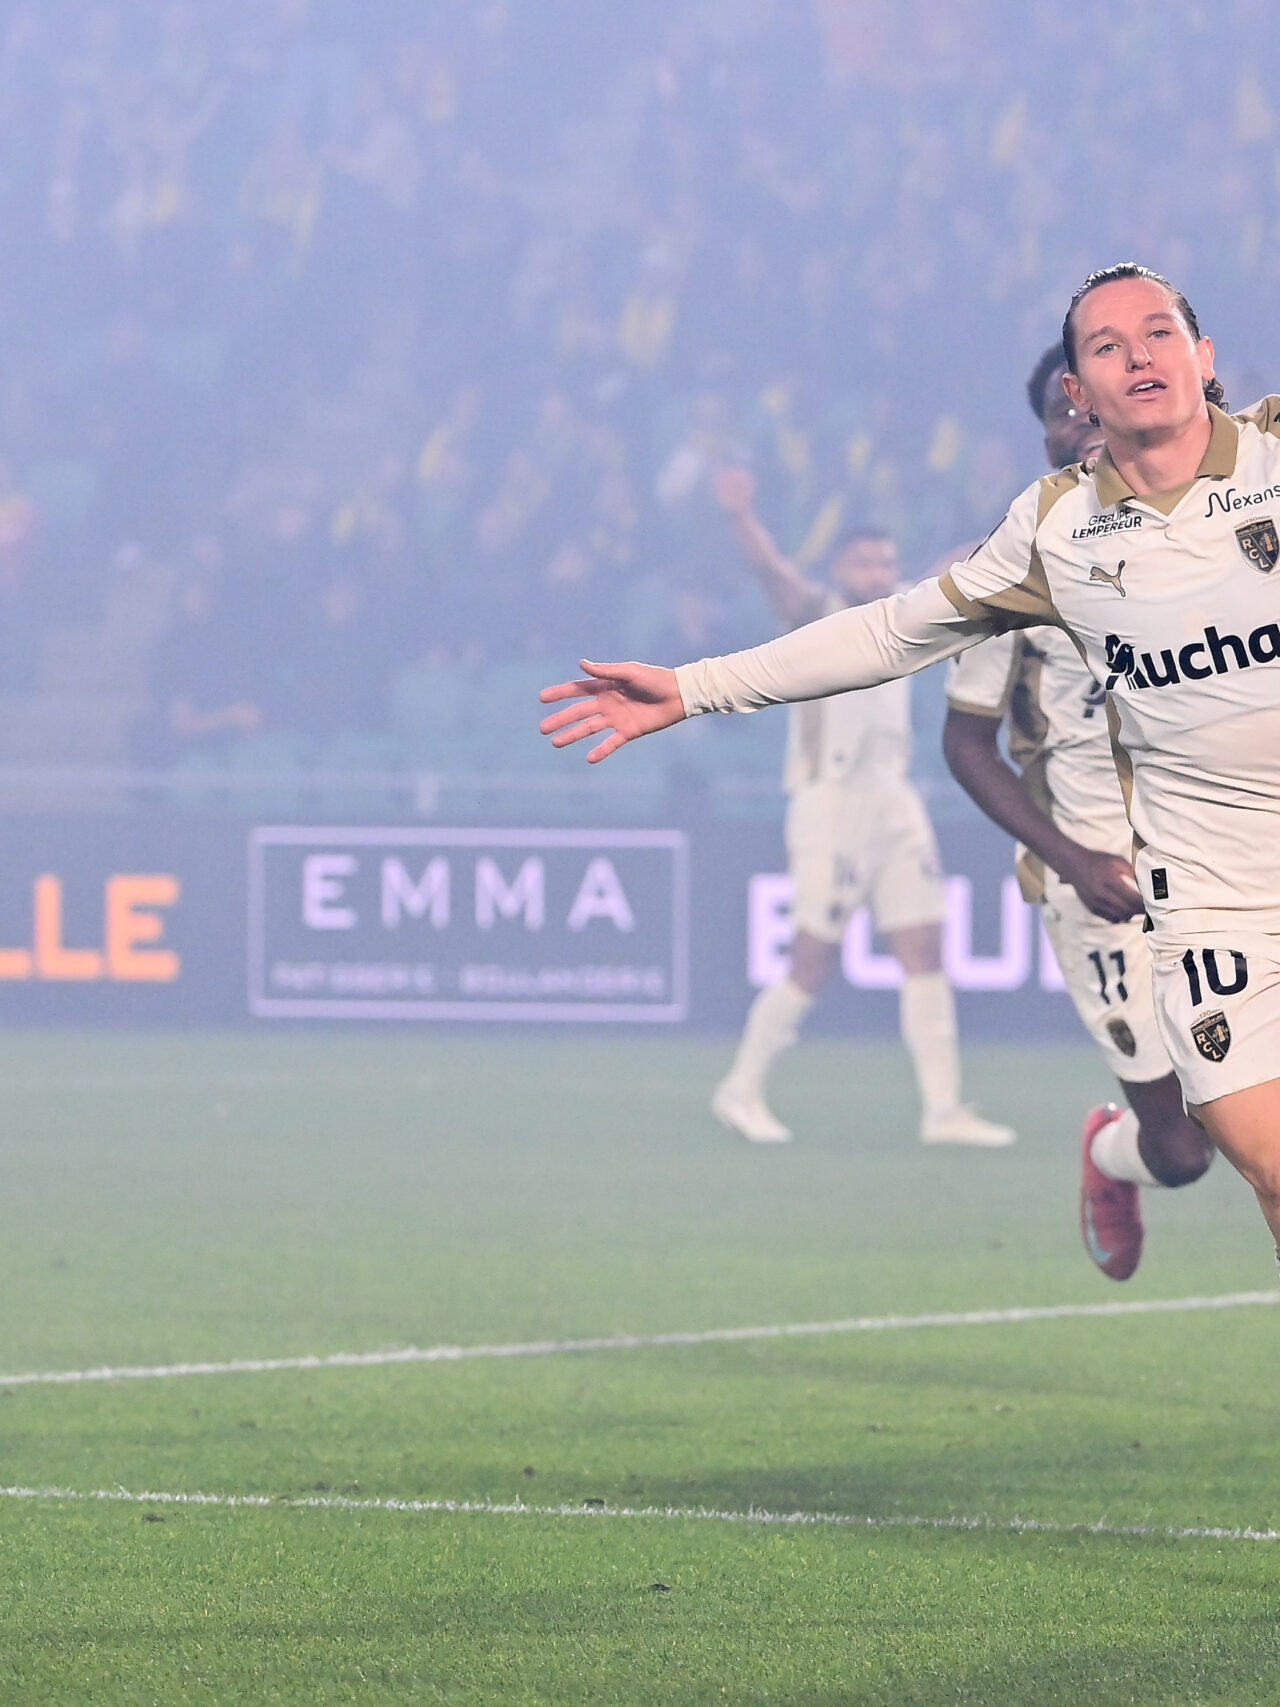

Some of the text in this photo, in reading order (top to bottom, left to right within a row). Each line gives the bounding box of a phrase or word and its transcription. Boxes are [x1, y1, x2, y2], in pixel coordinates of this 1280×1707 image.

[1071, 516, 1143, 539] LEMPEREUR
[1088, 507, 1131, 526] GROUPE
[1242, 538, 1270, 569] RCL
[302, 854, 635, 932] EMMA
[1181, 948, 1248, 1007] 10
[1196, 1033, 1222, 1060] RCL
